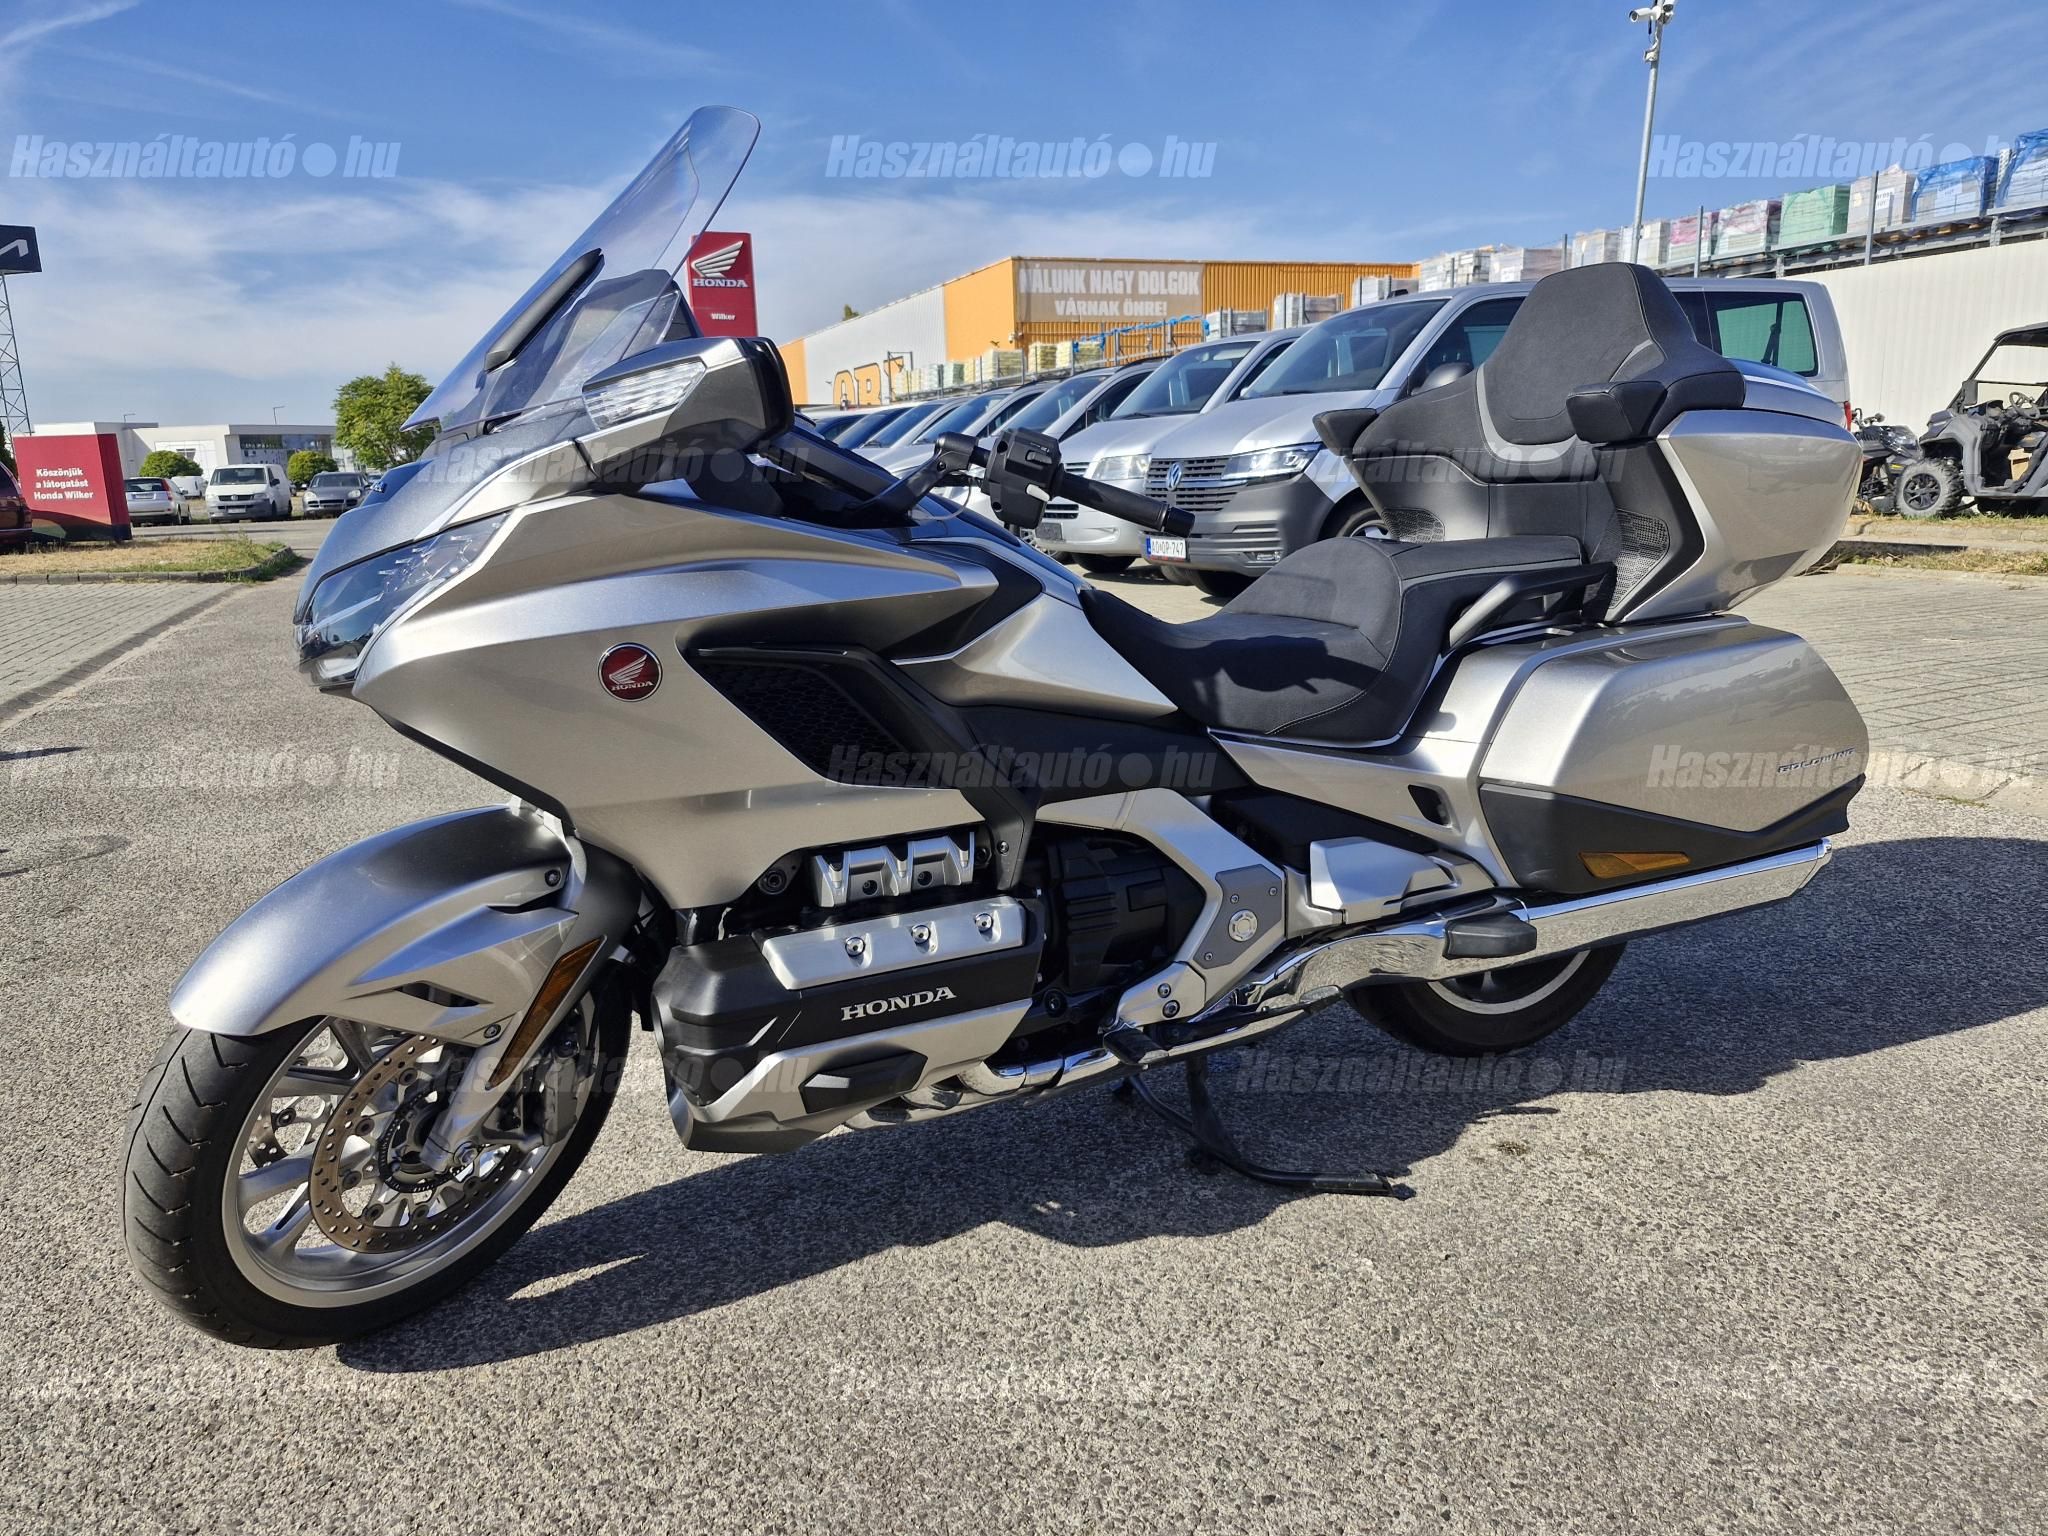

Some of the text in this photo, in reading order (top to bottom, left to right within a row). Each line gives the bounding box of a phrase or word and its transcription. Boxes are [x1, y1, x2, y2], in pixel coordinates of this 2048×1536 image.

[692, 278, 749, 288] HONDA
[1089, 270, 1135, 295] NAGY
[1138, 270, 1199, 296] DOLGOK
[1054, 297, 1168, 316] VÁRNAK ÖNRE!
[710, 312, 736, 320] Wilker
[36, 467, 84, 478] Köszönjük
[35, 479, 89, 489] a látogatást
[33, 490, 94, 500] Honda Wilker
[610, 680, 654, 691] HONDA
[840, 986, 957, 1021] HONDA
